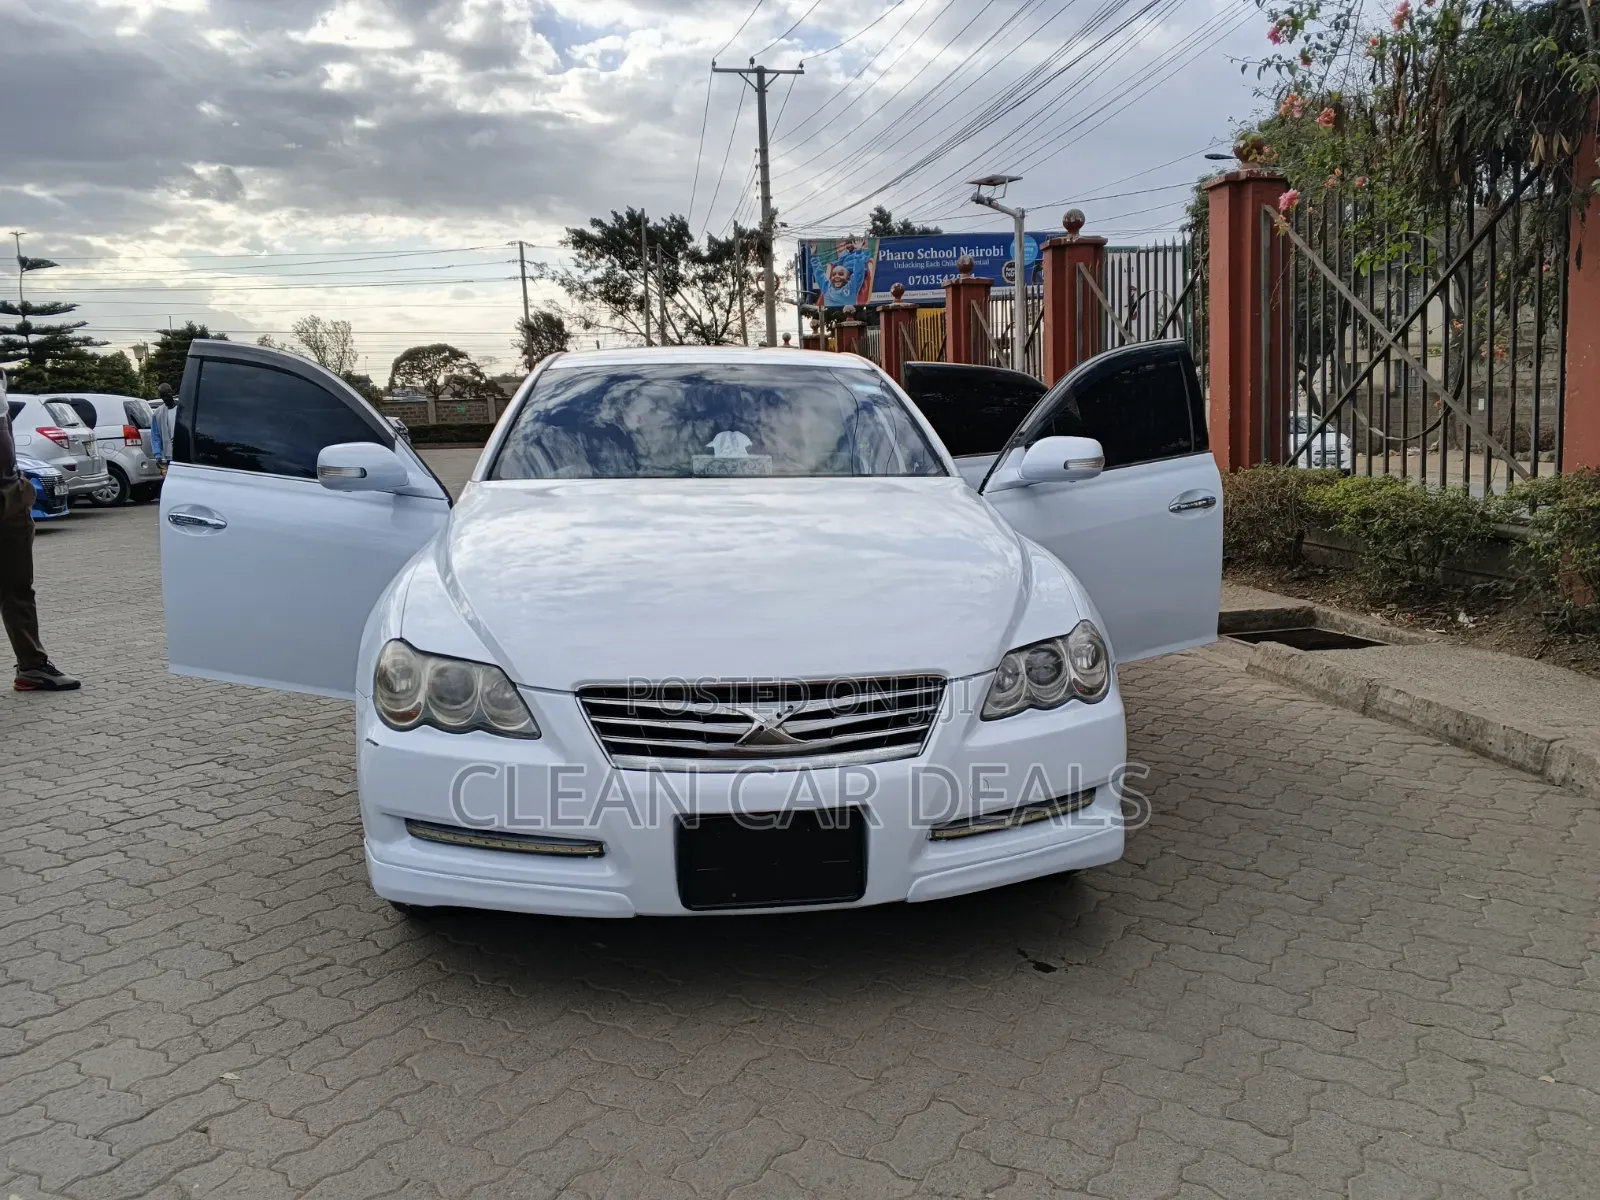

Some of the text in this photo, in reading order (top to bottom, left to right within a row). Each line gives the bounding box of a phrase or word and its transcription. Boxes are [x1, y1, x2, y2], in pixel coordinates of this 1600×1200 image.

[878, 245, 1004, 261] Pharo School Nairobi
